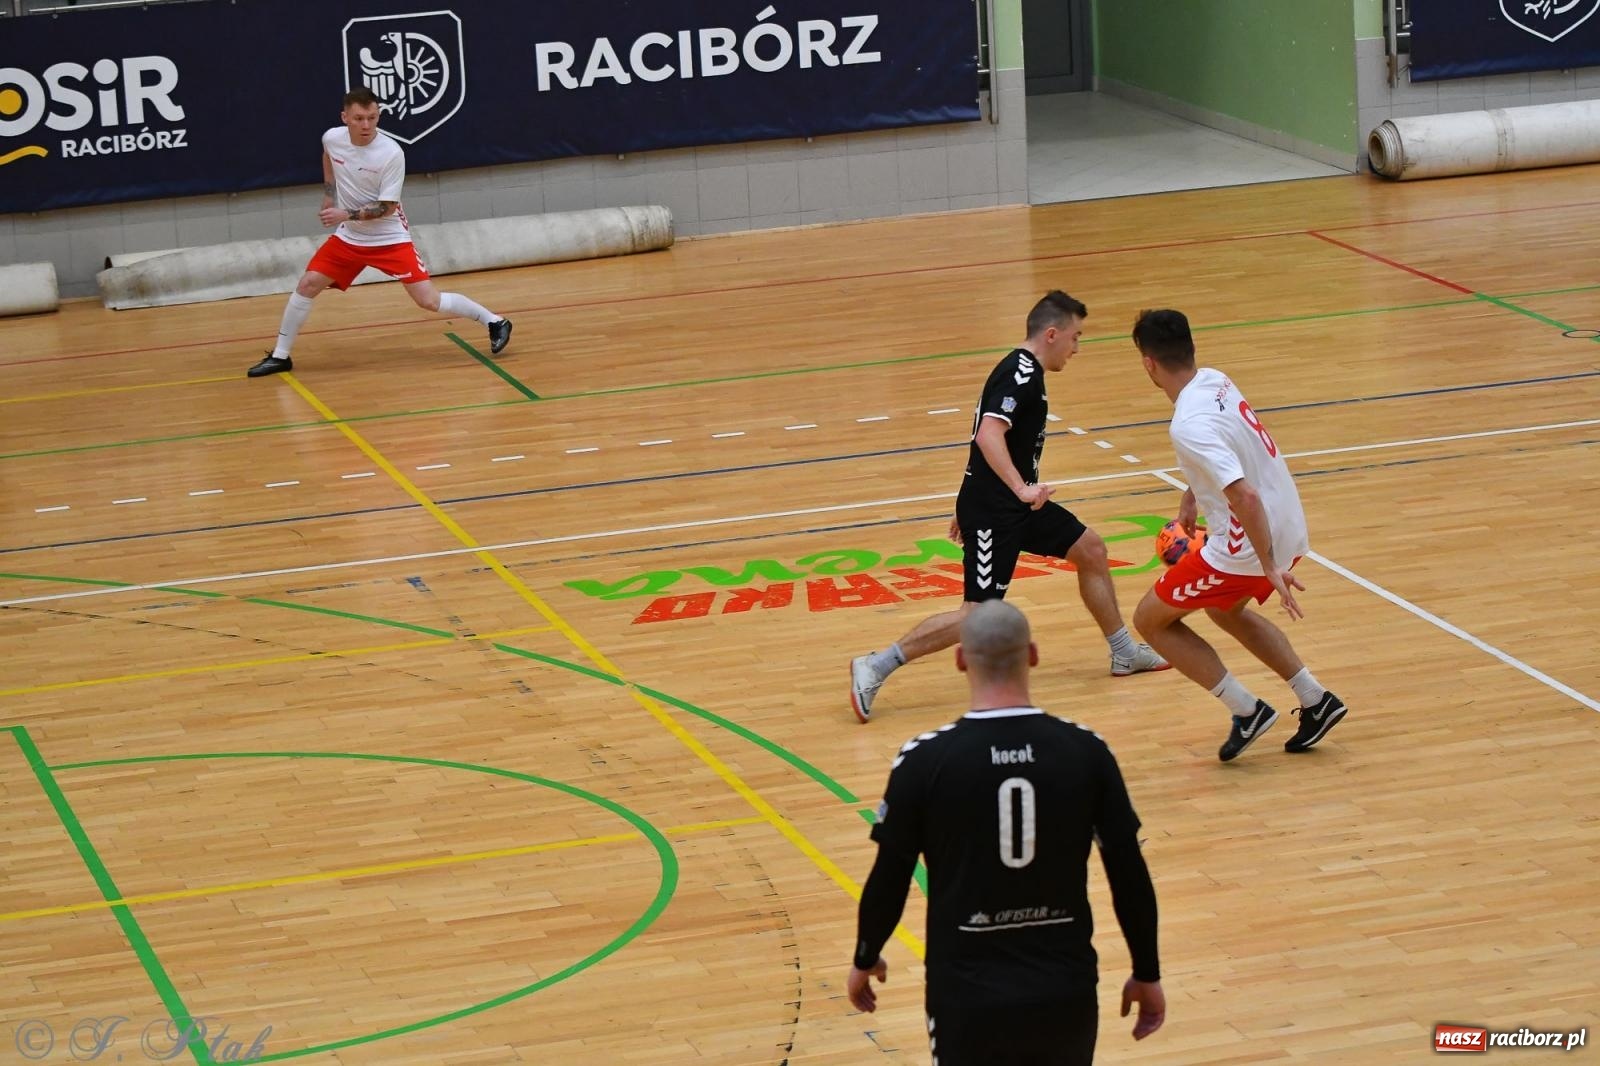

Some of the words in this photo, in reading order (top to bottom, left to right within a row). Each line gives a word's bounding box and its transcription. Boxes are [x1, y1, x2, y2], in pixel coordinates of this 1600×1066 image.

[535, 5, 882, 92] RACIBÓRZ
[60, 126, 189, 159] RACIBÓRZ
[1239, 401, 1277, 459] 8
[990, 743, 1035, 765] kocot
[997, 776, 1037, 869] 0
